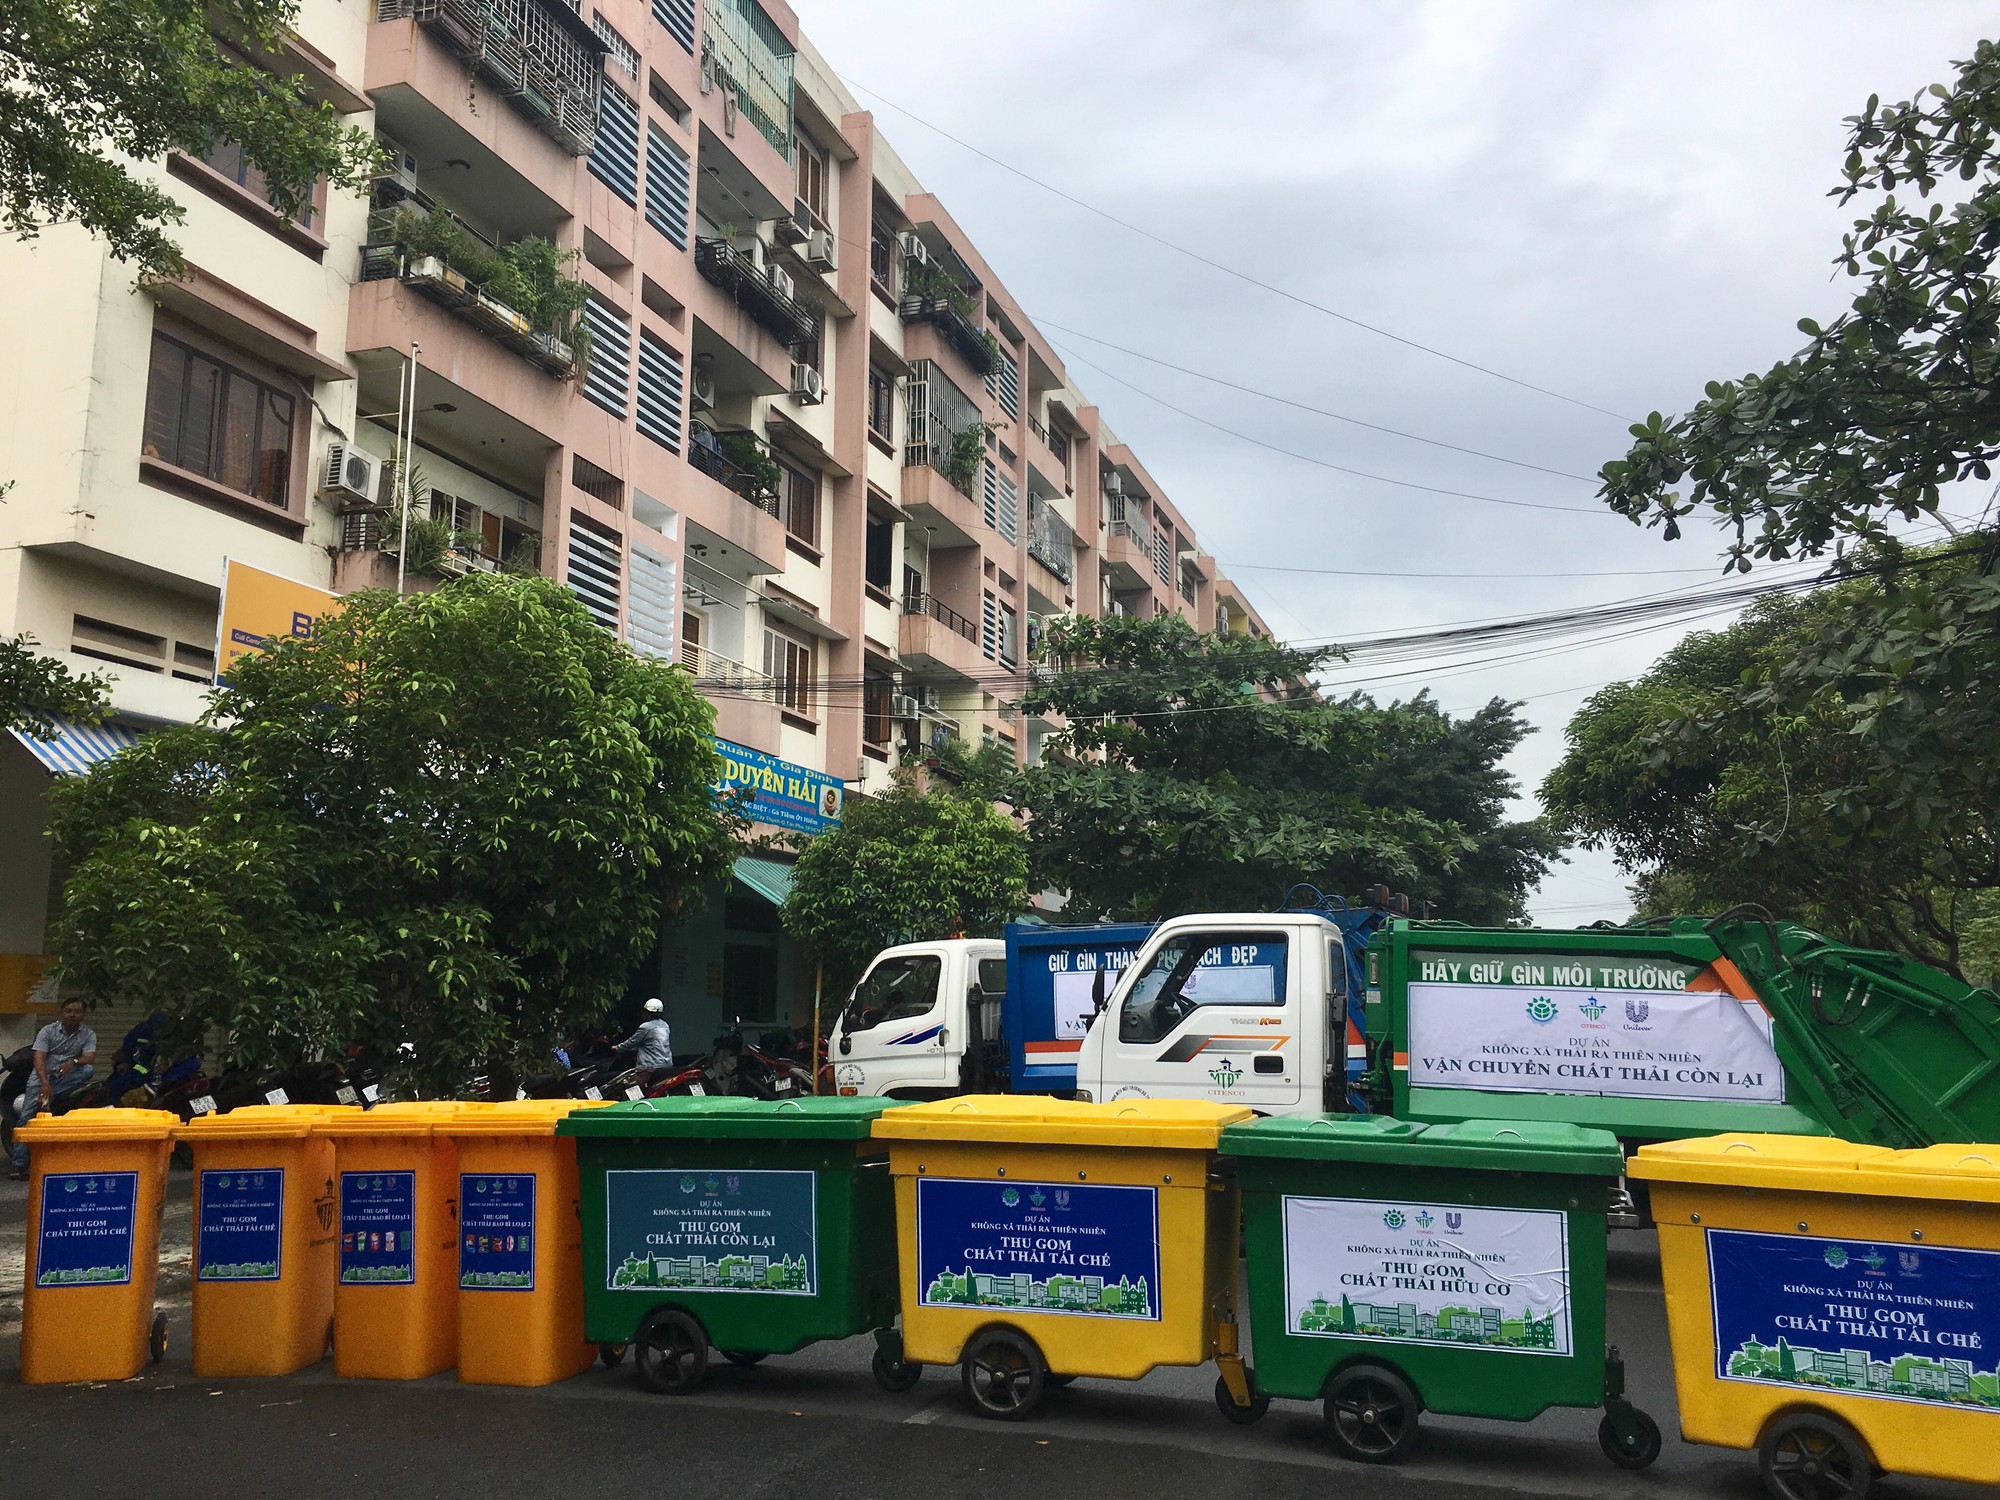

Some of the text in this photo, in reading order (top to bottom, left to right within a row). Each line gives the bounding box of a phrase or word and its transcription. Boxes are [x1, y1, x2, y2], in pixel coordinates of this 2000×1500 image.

[725, 759, 785, 794] DUYÊN
[789, 777, 816, 803] HẢI
[1048, 950, 1068, 972] GIỮ
[1076, 948, 1097, 971] GÌN
[1232, 945, 1258, 966] ĐẸP
[1421, 958, 1686, 990] HÃY GIỮ GÌN MÔI TRƯỜNG
[1568, 1035, 1610, 1050] DỰ ÁN
[1482, 1043, 1701, 1063] KHÔNG XẢ THẢI RA THIÊN NHIÊN
[1423, 1057, 1462, 1073] VẬN
[1620, 1064, 1670, 1082] THẢI
[1675, 1065, 1722, 1084] CÒN
[1728, 1071, 1764, 1088] LẠI
[679, 1221, 741, 1233] THU GOM
[685, 1232, 718, 1245] THẢI
[719, 1232, 749, 1245] CÒN
[753, 1235, 776, 1248] LẠI
[1001, 1236, 1072, 1251] THU GOM
[1409, 1238, 1440, 1248] DỰ ÁN
[1008, 1249, 1045, 1263] THẢI
[1049, 1251, 1075, 1265] TÁI
[1347, 1244, 1506, 1263] KHÔNG XẢ THẢI RA THIÊN NHIÊN
[1382, 1261, 1465, 1278] THU GOM
[1392, 1274, 1435, 1291] THẢI
[1442, 1278, 1480, 1294] HỮU
[1485, 1282, 1511, 1297] CƠ
[1857, 1280, 1893, 1291] DỰ ÁN
[1783, 1283, 1974, 1310] KHÔNG XẢ THẢI RA THIÊN NHIÊN
[1825, 1303, 1926, 1327] THU GOM
[1836, 1318, 1887, 1339] THẢI
[1893, 1324, 1931, 1344] TÁI
